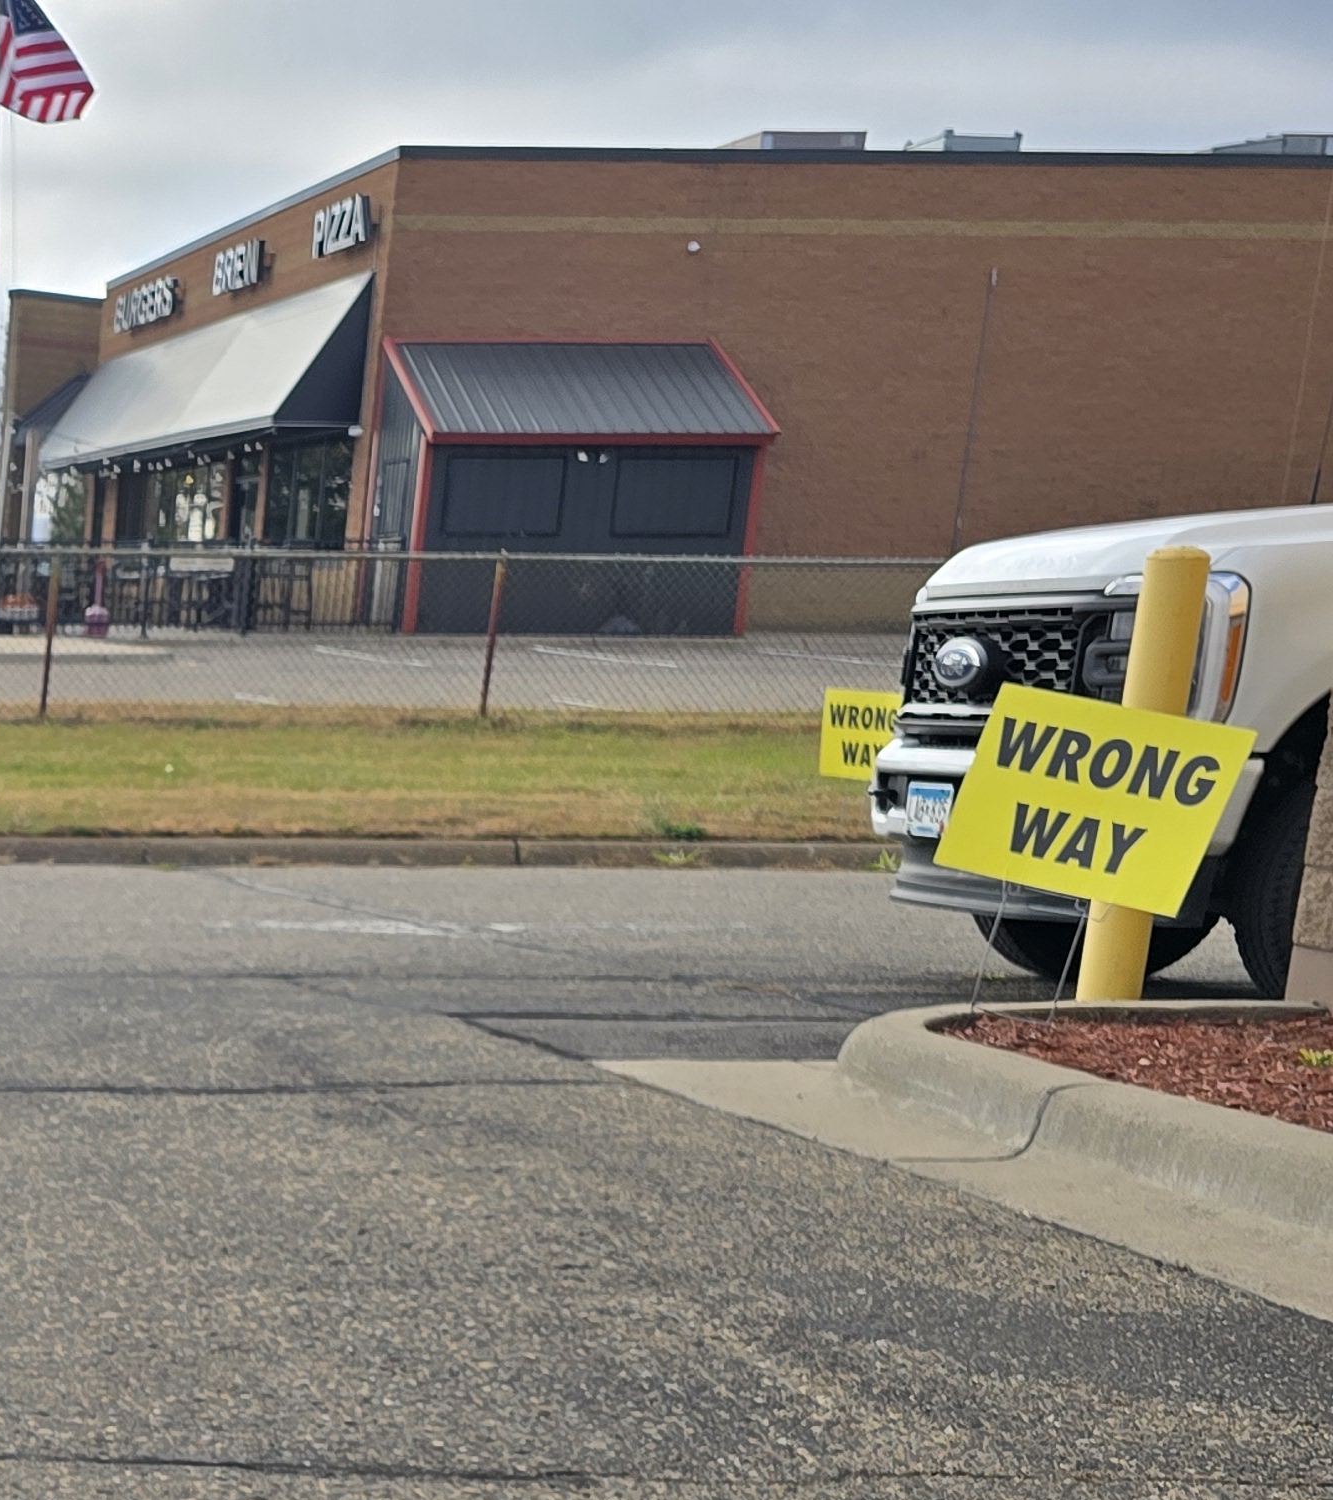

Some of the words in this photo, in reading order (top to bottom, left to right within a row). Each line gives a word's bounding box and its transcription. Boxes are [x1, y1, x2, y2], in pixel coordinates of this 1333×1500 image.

[312, 193, 368, 259] PIZZA
[996, 716, 1221, 807] WRONG
[1009, 802, 1147, 875] WAY
